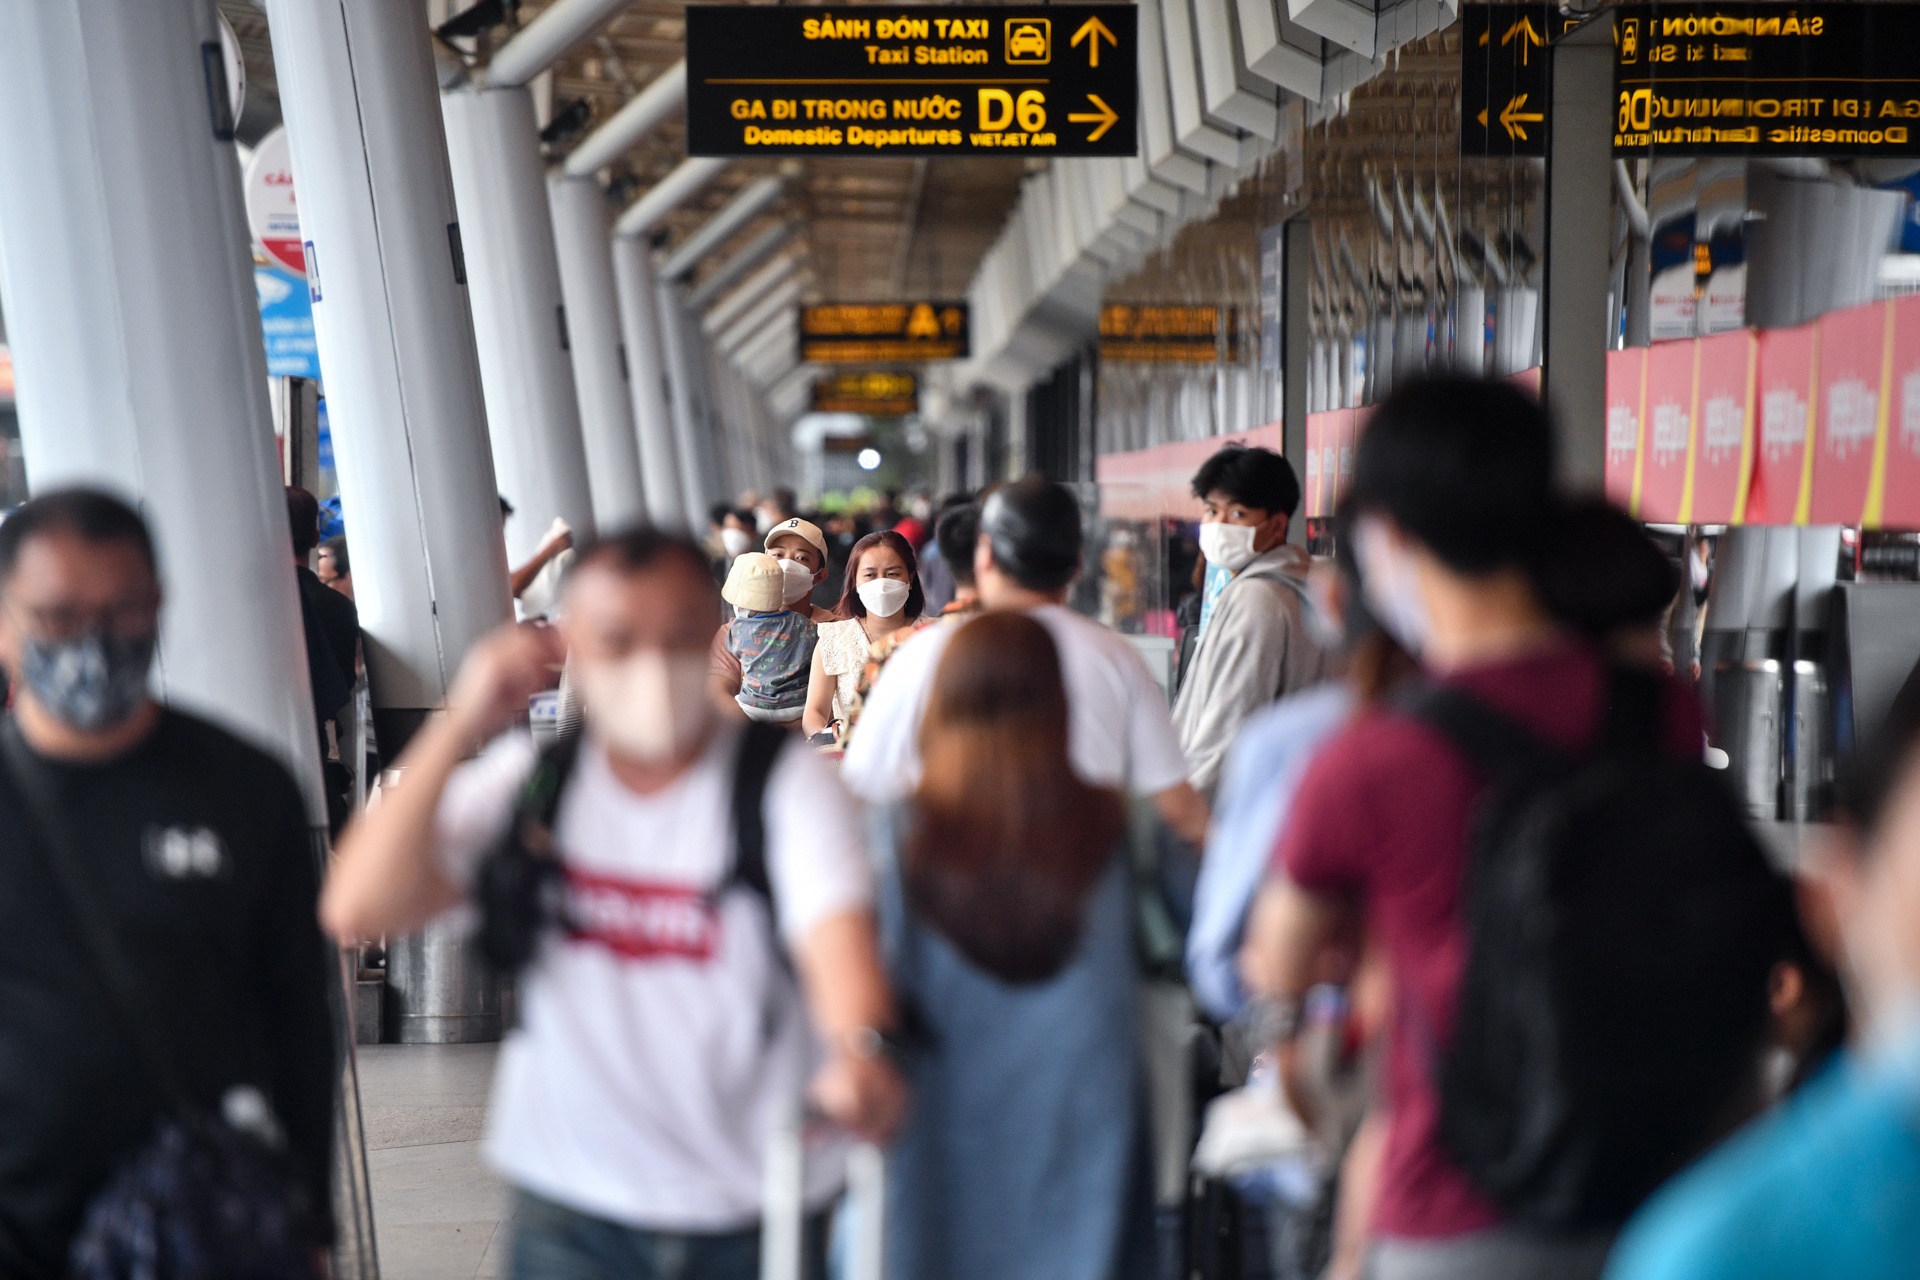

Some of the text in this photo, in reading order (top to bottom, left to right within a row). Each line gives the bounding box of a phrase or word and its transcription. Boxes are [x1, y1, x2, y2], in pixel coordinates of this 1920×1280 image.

[803, 14, 989, 39] SẢNH ĐÓN TAXI
[865, 46, 988, 64] Taxi Station
[731, 95, 961, 120] GA ĐI TRONG NƯỚC
[978, 88, 1047, 133] D6
[744, 126, 962, 149] Domestic Departures
[970, 133, 1056, 146] VIETJET AIR
[788, 519, 799, 528] B
